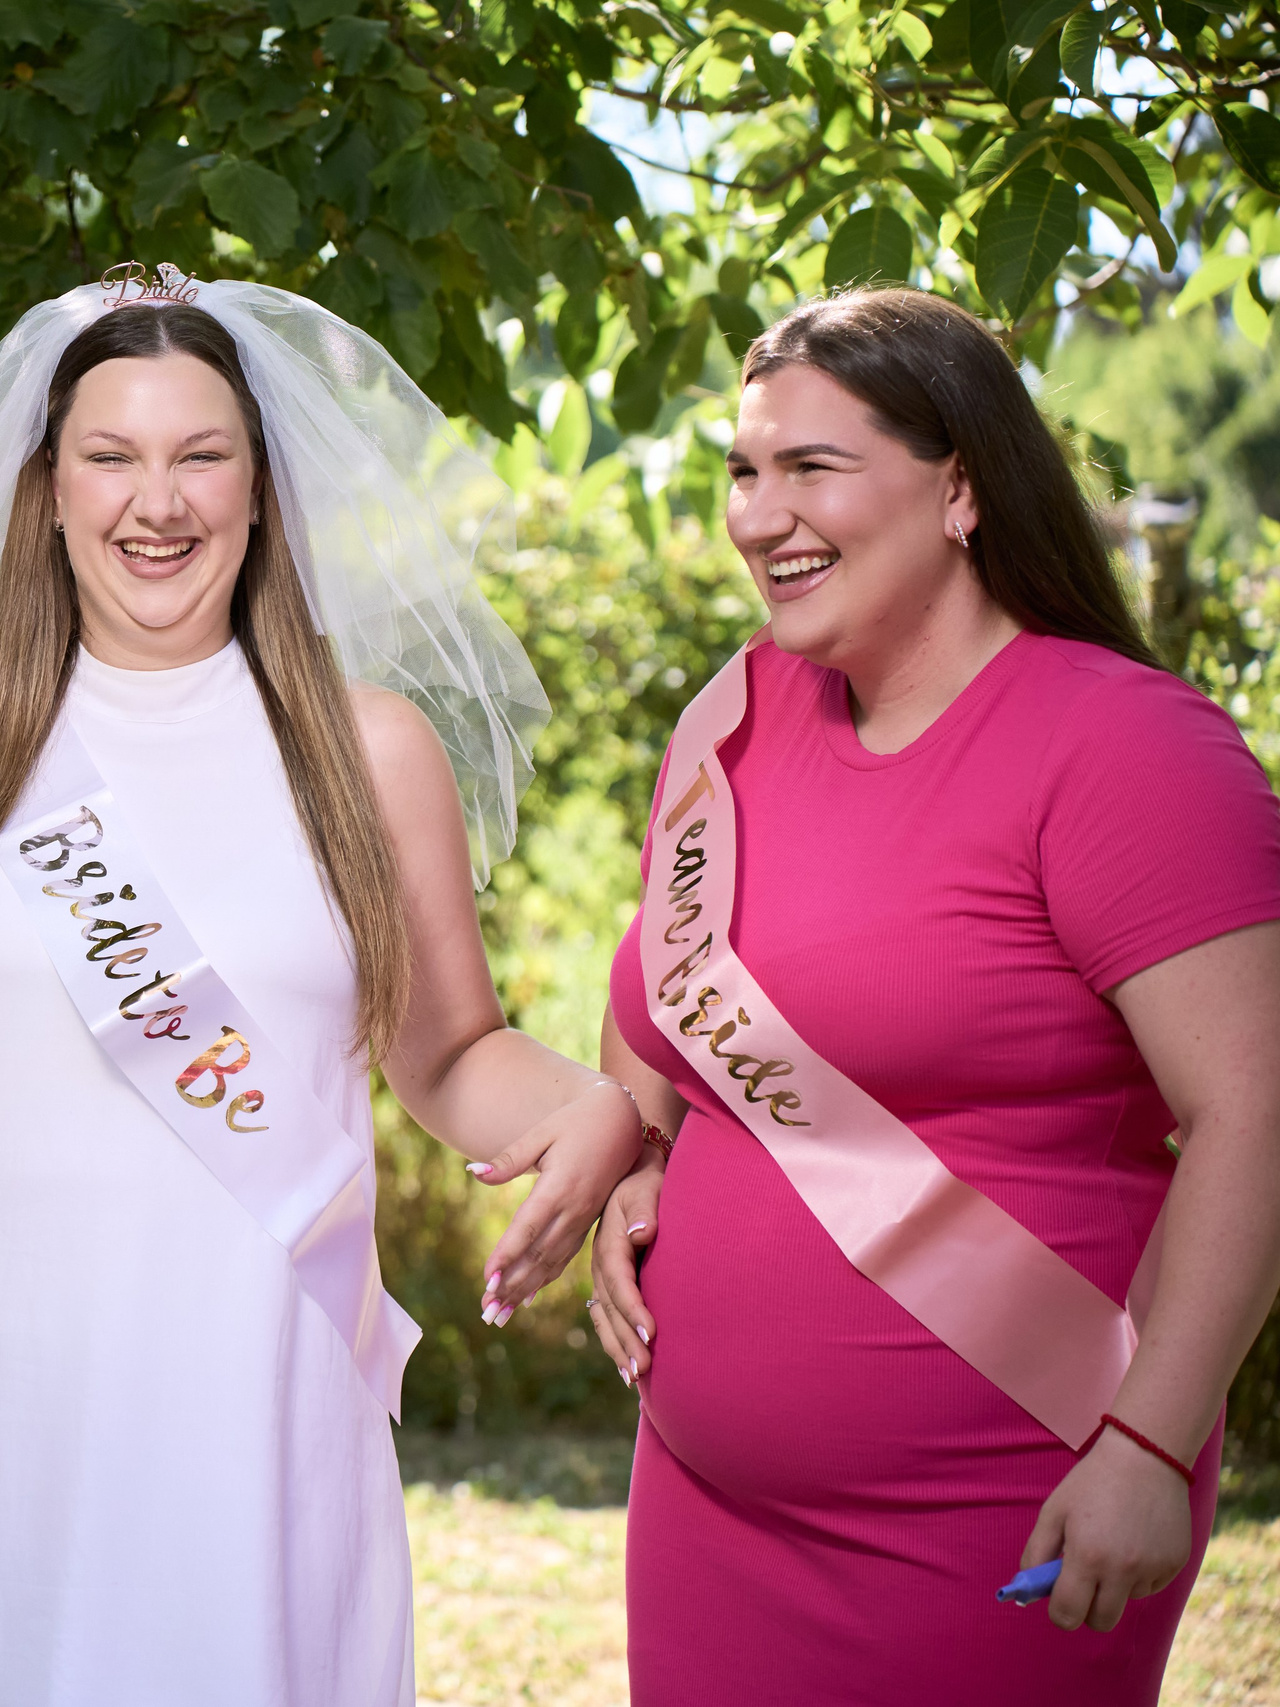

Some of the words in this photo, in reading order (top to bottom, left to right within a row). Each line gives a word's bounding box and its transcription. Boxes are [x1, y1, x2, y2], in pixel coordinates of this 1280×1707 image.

[101, 260, 198, 307] Bride
[665, 760, 716, 944] Team
[19, 805, 163, 979] Bride
[119, 970, 191, 1040] to
[175, 1025, 269, 1134] Be
[658, 931, 812, 1127] Bride
